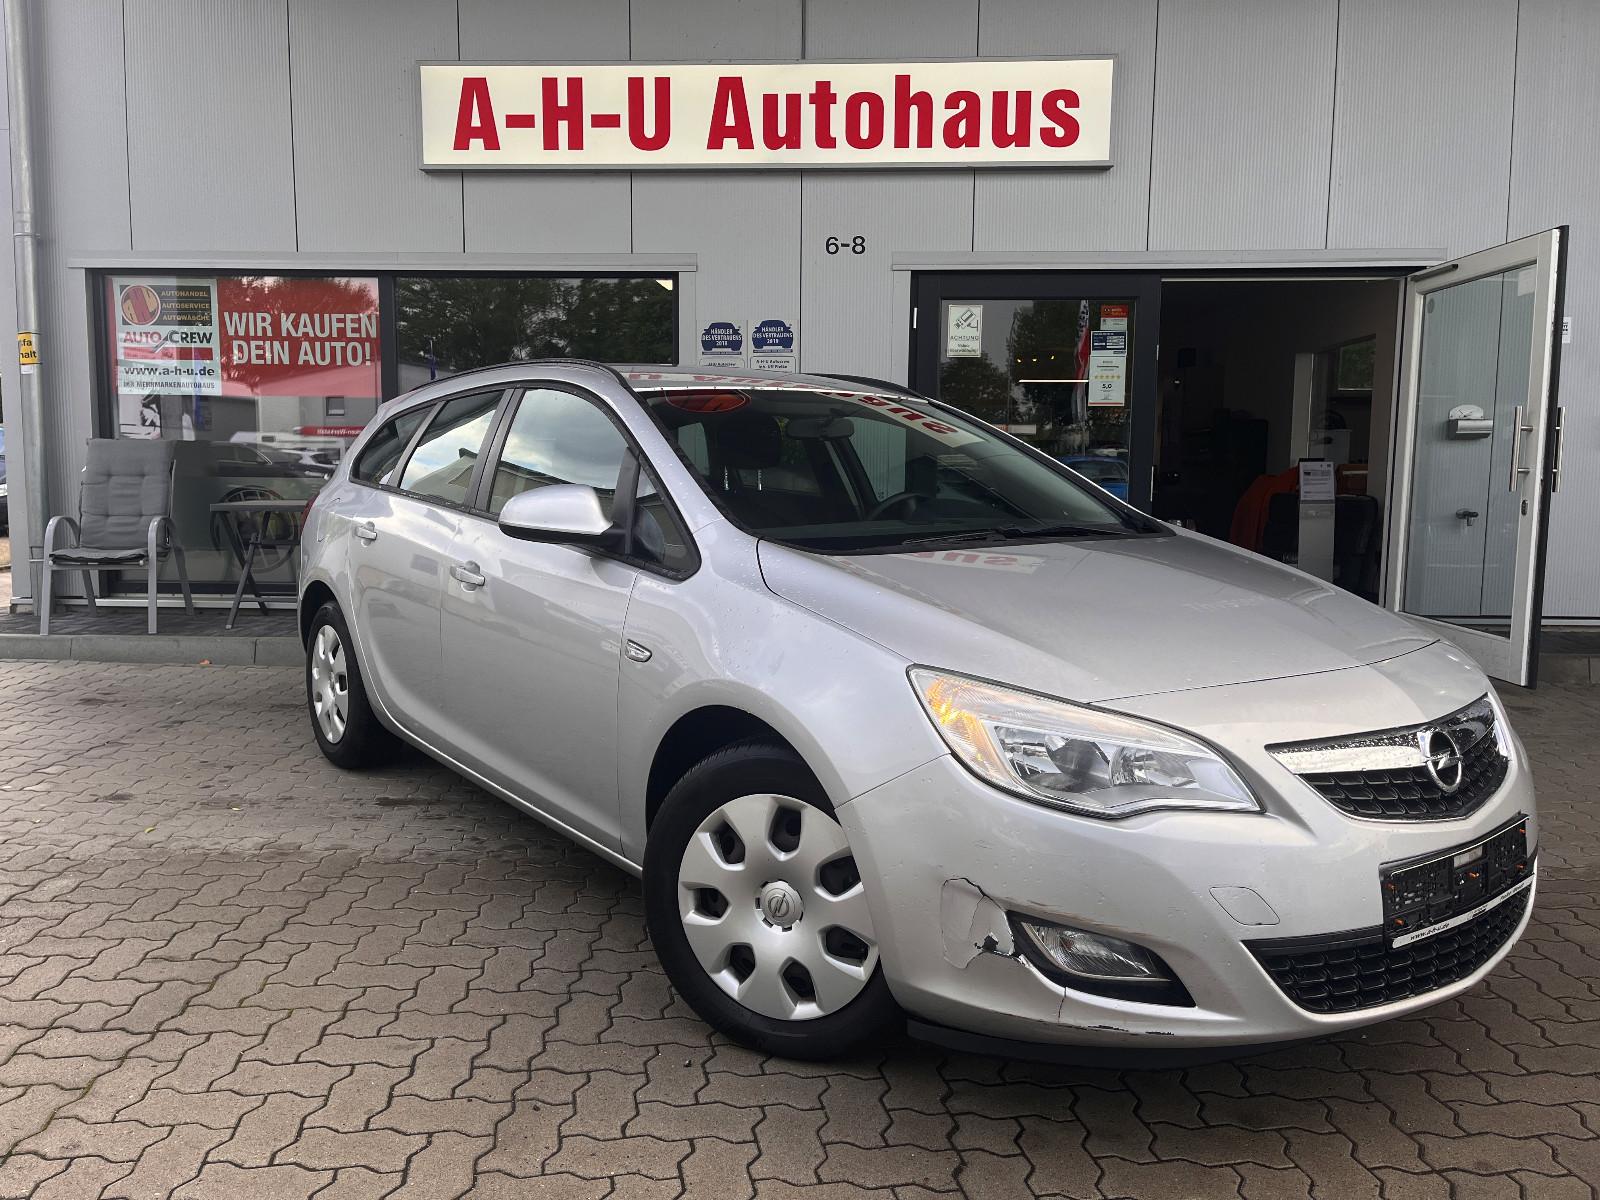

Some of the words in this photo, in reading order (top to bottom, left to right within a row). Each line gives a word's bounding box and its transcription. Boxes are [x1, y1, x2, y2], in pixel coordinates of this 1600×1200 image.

[453, 76, 671, 151] A-H-U
[706, 74, 1081, 150] Autohaus
[825, 235, 866, 255] 6-8
[223, 311, 273, 337] WIR
[280, 312, 377, 339] KAUFEN
[124, 331, 162, 343] AUTO
[168, 330, 212, 344] CREW
[232, 339, 290, 365] DEIN
[298, 341, 371, 366] AUTO!
[124, 366, 215, 376] www.a-h-u.de
